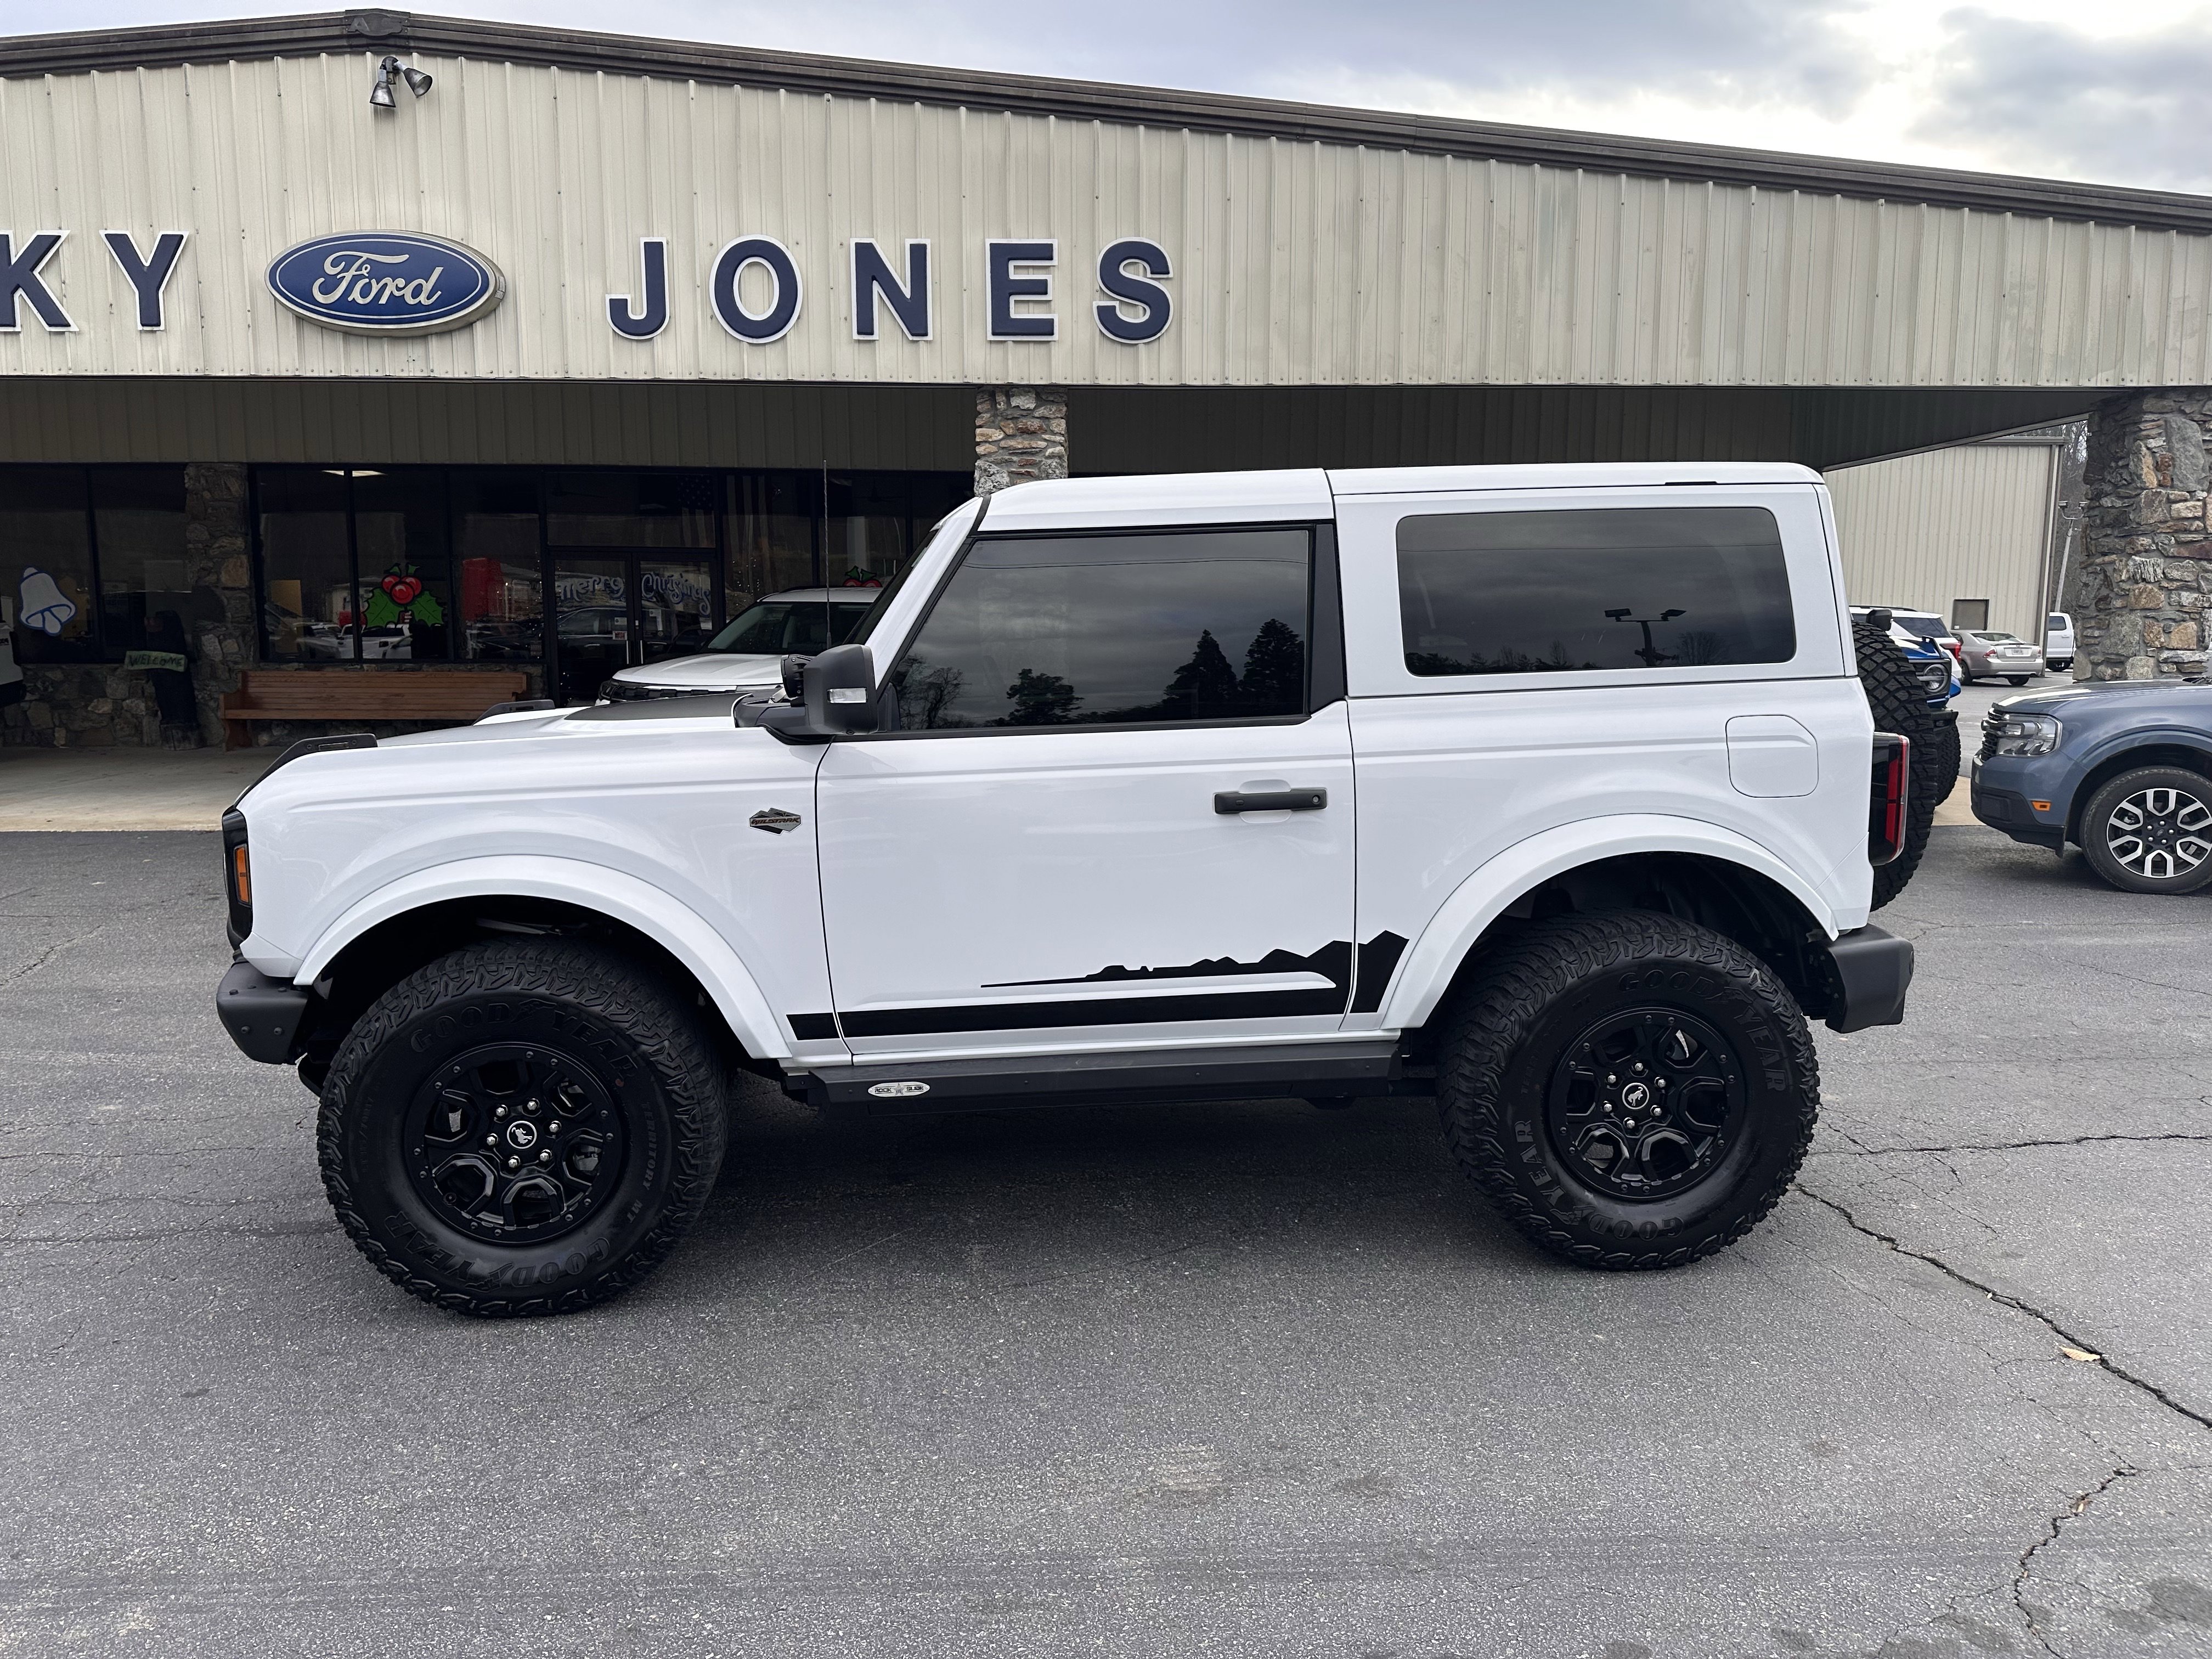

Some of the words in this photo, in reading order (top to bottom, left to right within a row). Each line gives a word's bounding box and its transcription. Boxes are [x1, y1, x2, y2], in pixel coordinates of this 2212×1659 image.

[0, 230, 189, 331] KY
[606, 234, 1173, 344] JONES
[312, 250, 444, 307] Ford
[129, 654, 183, 667] WELCOME
[641, 1101, 657, 1190] TERRITORY
[626, 1199, 644, 1223] MT
